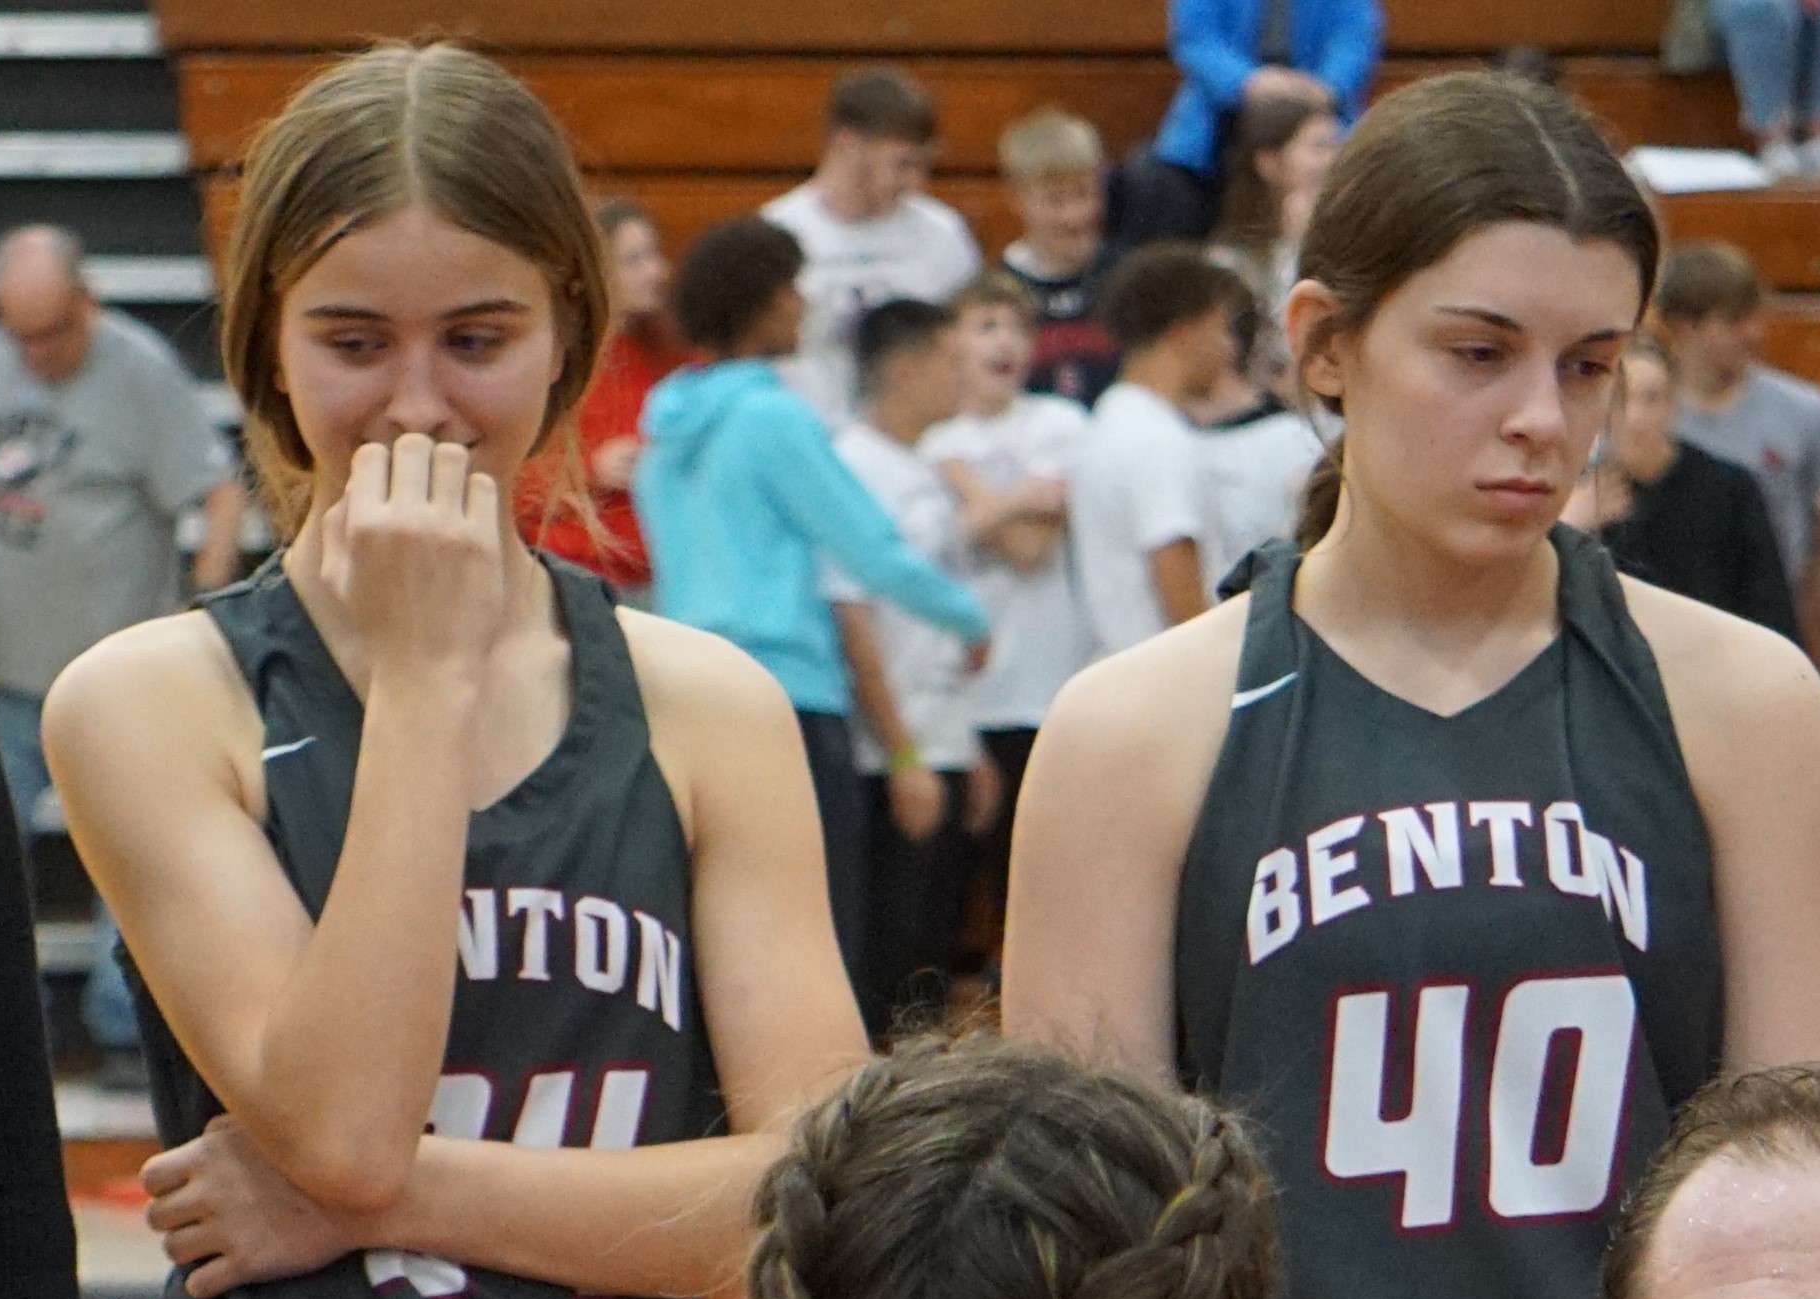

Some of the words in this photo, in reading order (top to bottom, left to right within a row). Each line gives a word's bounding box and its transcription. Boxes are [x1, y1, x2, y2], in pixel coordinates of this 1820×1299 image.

[457, 886, 682, 1033] NTON
[1246, 800, 1650, 966] BENTON
[1321, 970, 1639, 1233] 40
